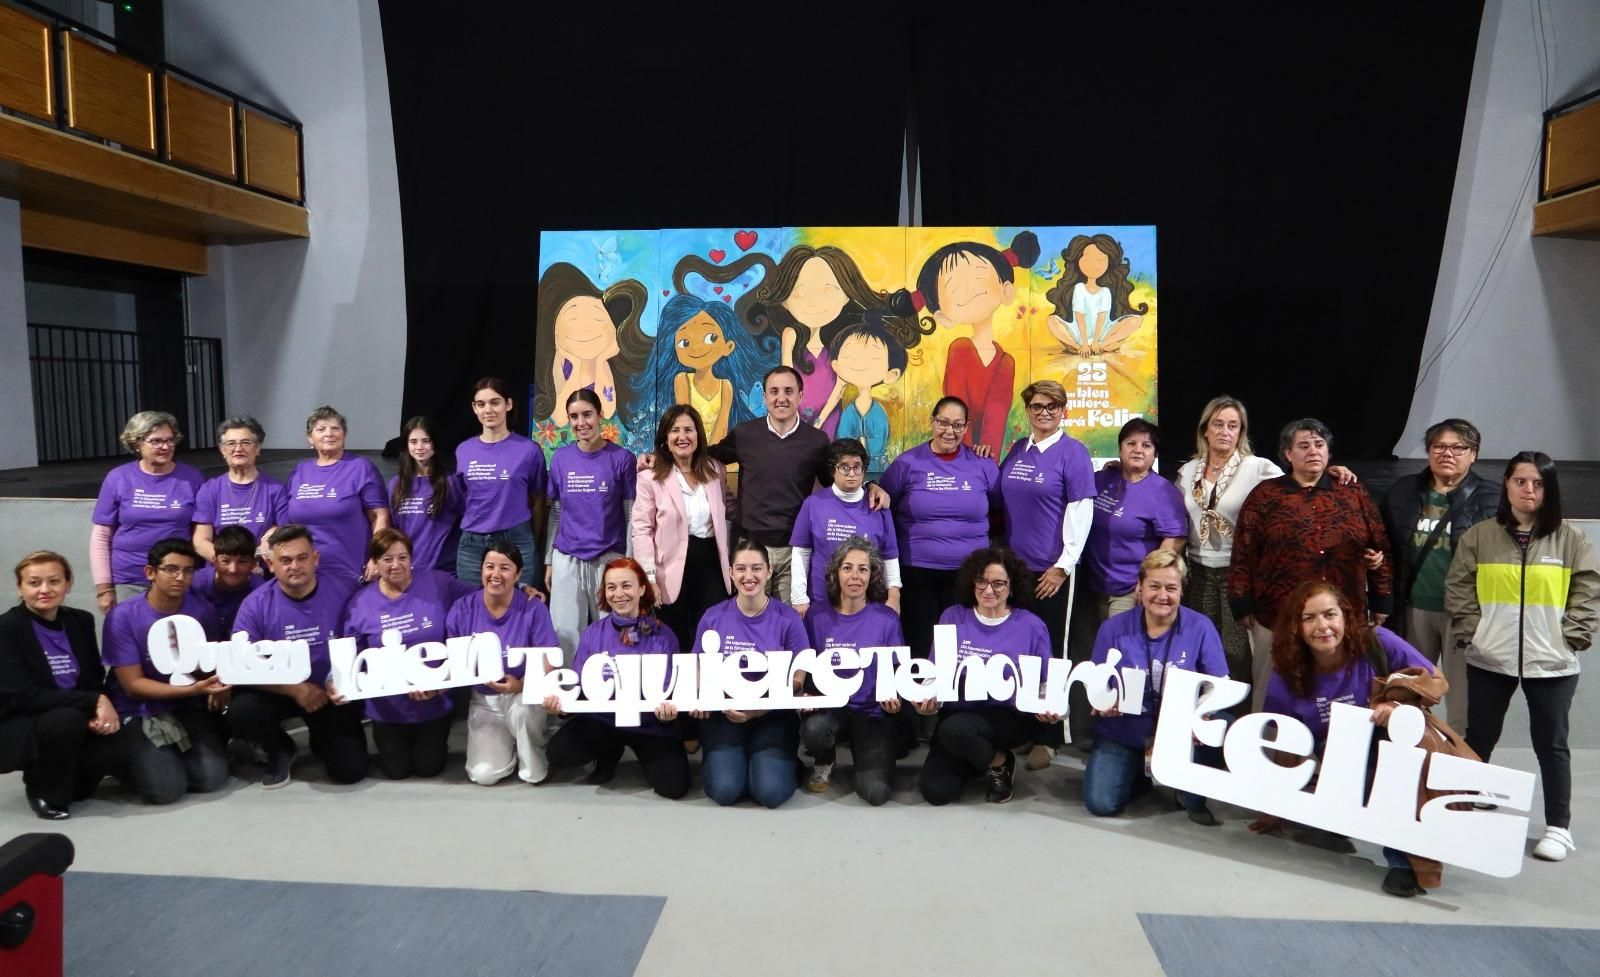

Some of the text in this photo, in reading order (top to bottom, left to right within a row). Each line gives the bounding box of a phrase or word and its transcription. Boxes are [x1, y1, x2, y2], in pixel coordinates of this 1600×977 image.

[1077, 362, 1107, 382] 25
[1077, 387, 1109, 398] bien
[147, 614, 311, 686] Quien
[329, 629, 505, 702] bien
[1150, 667, 1536, 878] Feliz
